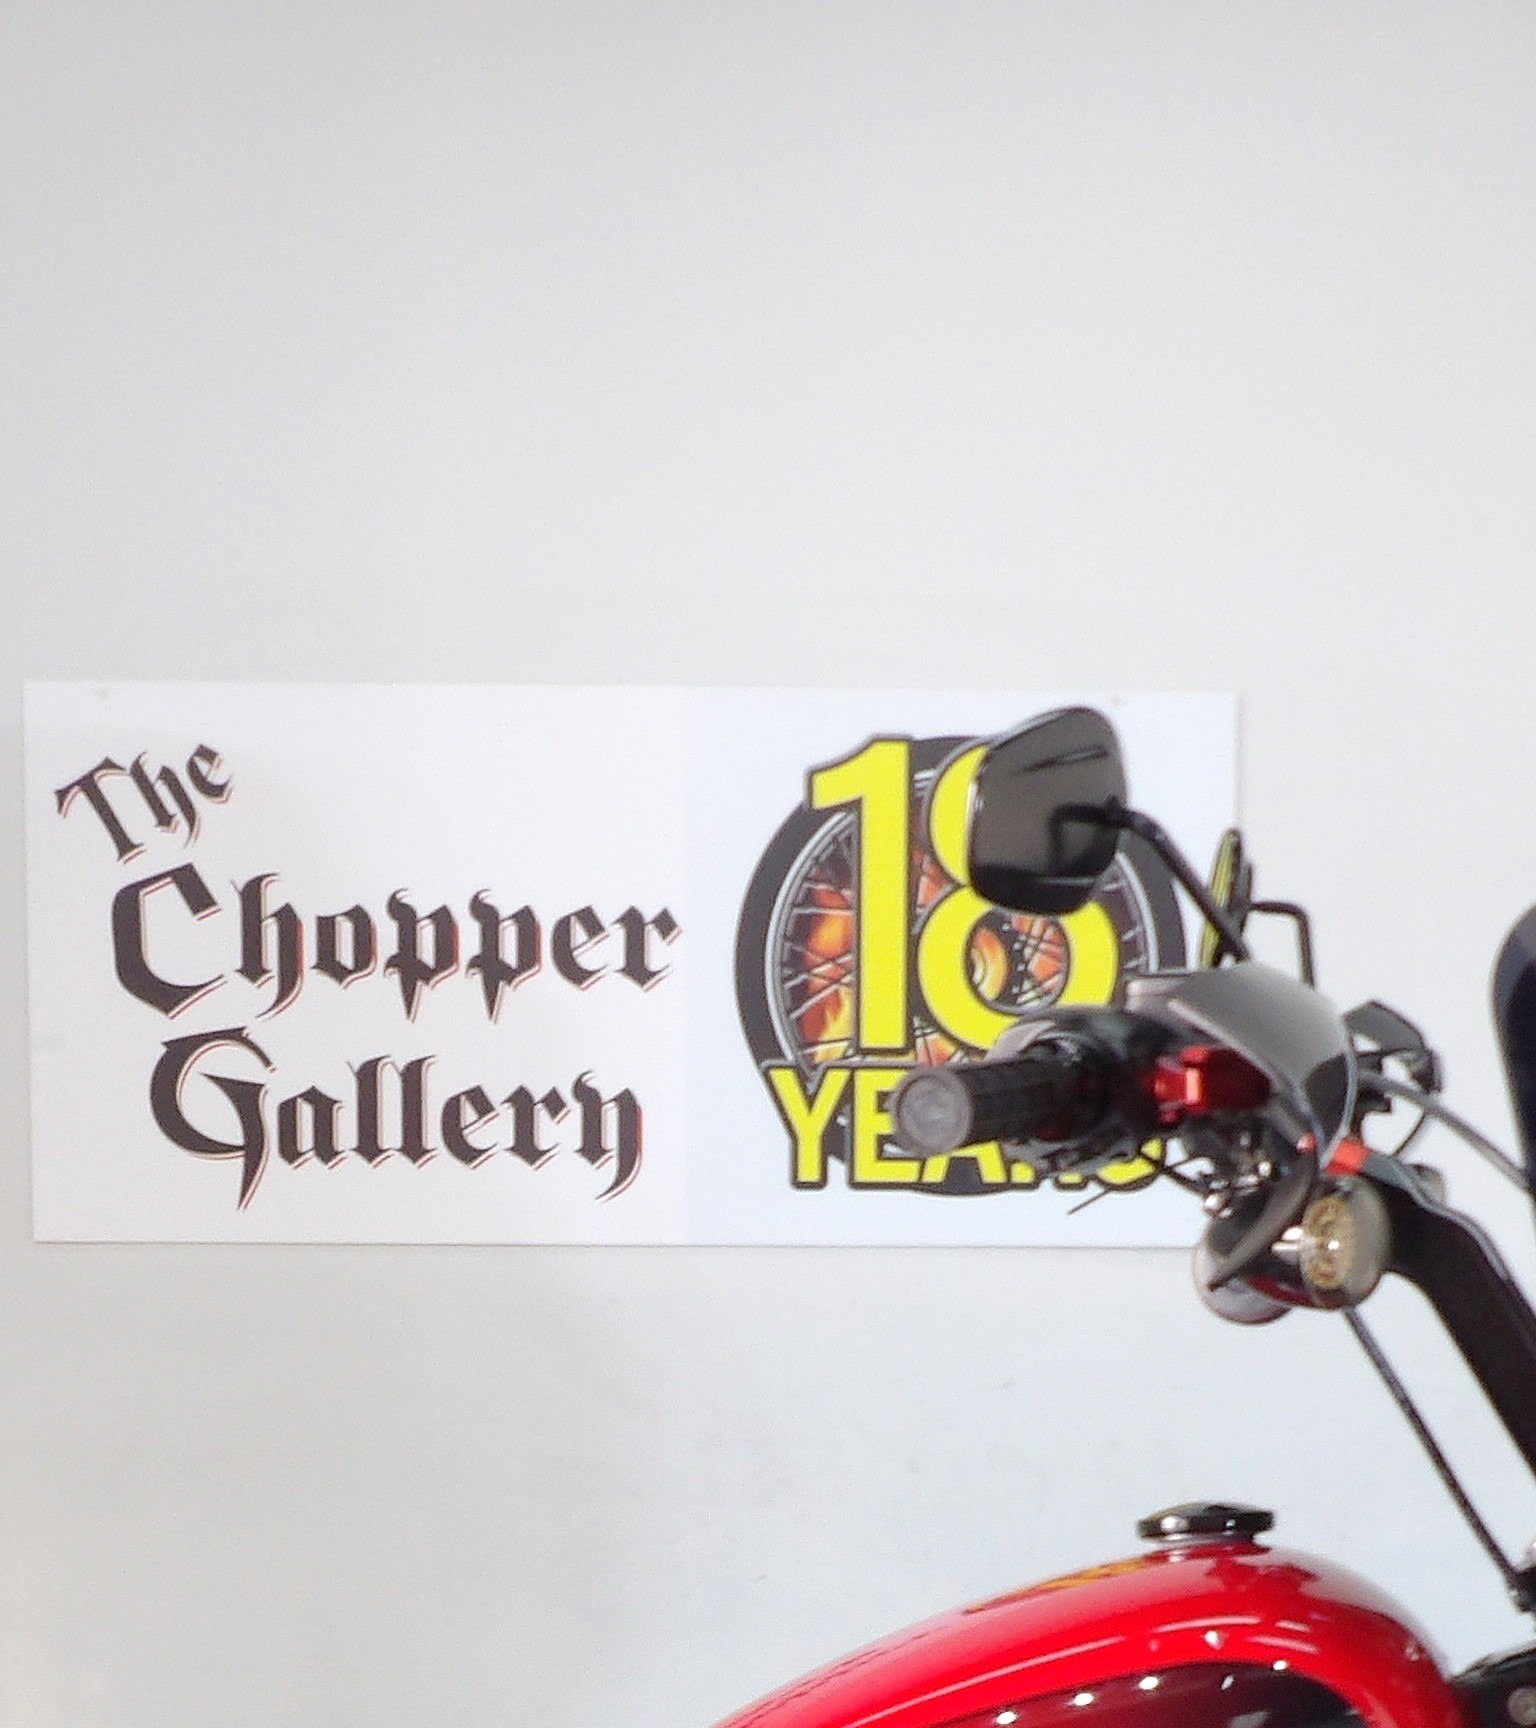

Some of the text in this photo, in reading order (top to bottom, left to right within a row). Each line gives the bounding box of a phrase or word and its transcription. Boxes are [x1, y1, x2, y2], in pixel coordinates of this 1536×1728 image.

[54, 742, 232, 864] The
[110, 862, 680, 1022] Chopper
[809, 735, 1119, 1053] 18
[148, 1025, 644, 1211] Gallery
